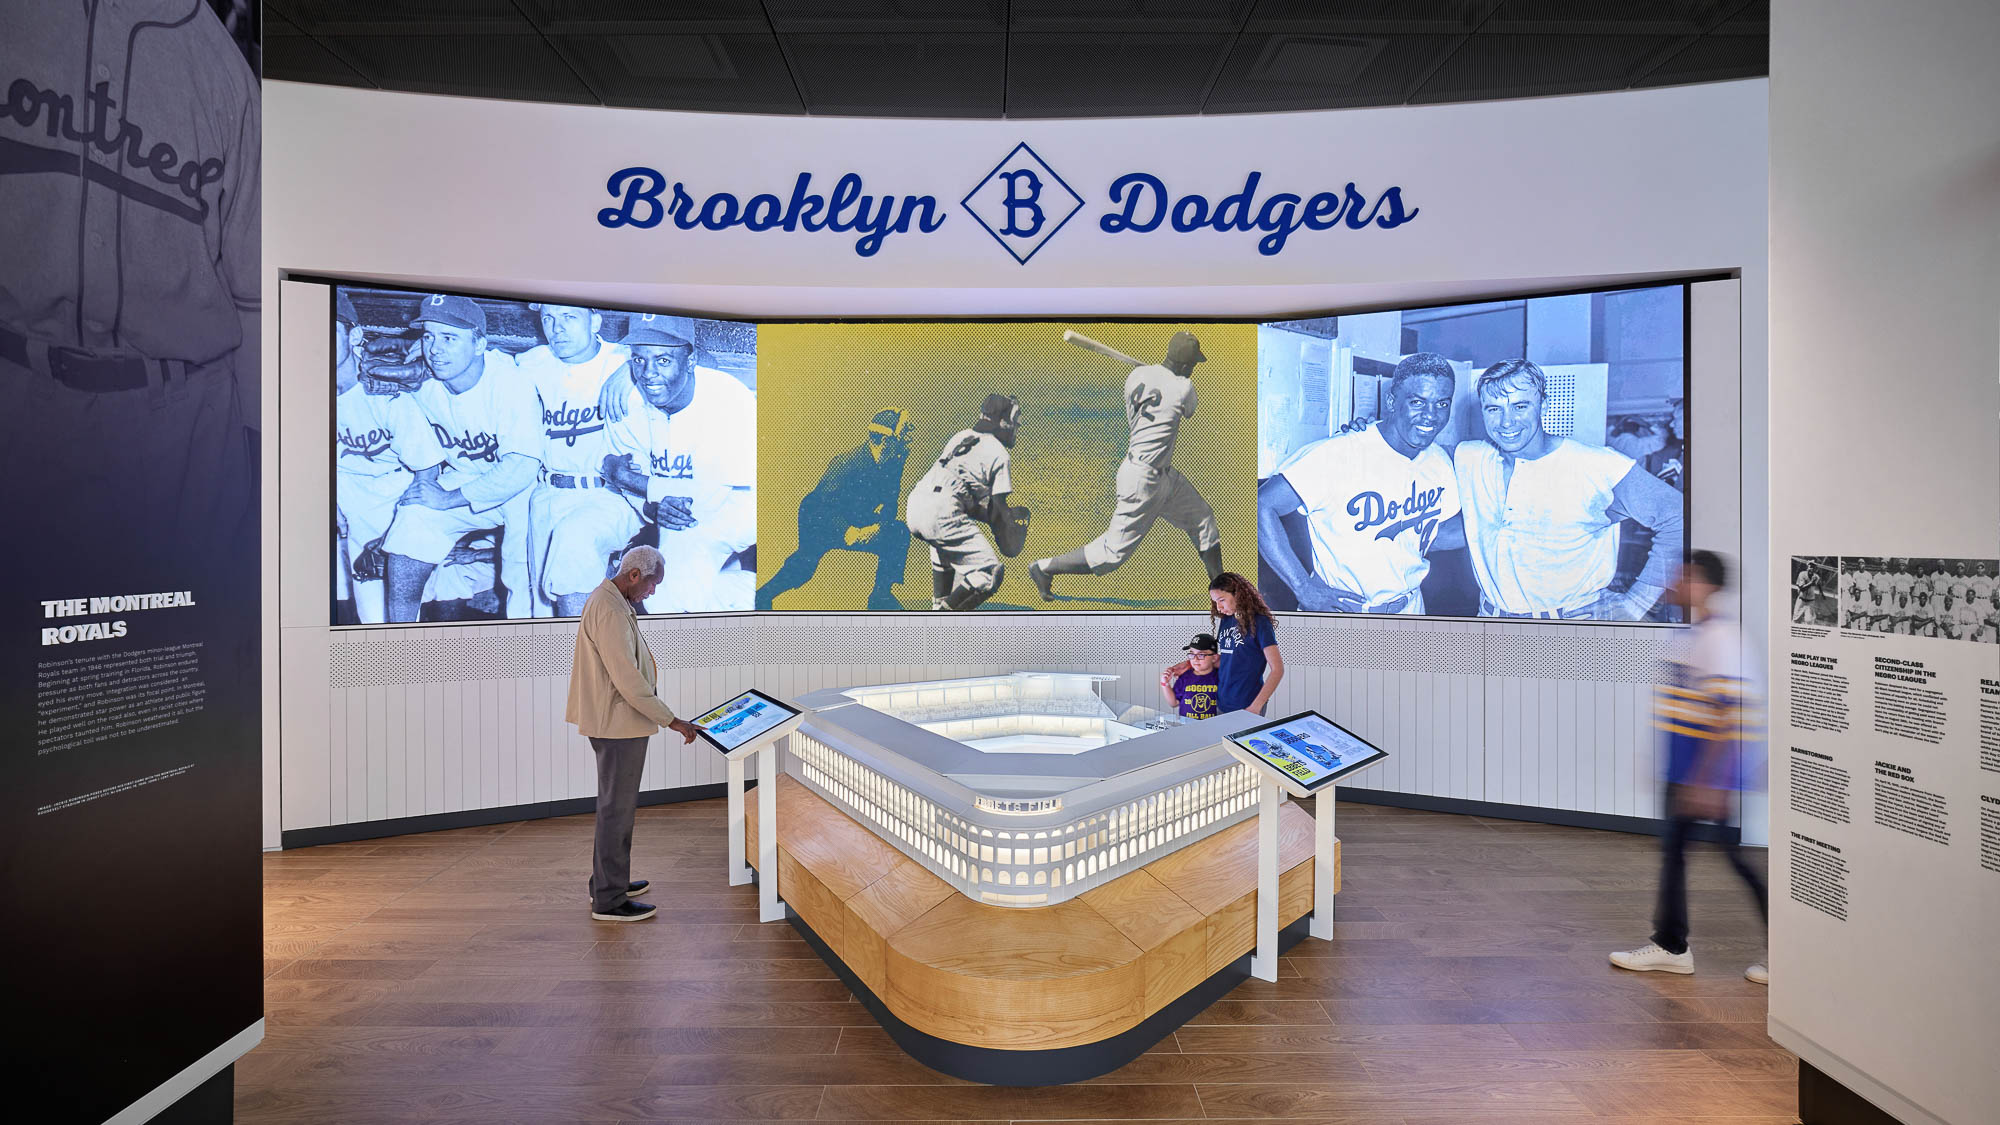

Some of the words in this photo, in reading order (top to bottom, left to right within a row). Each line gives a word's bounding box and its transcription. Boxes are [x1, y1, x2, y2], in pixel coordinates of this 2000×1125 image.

[597, 166, 946, 257] Brooklyn
[999, 169, 1046, 238] B
[1100, 171, 1419, 256] Dodgers
[41, 598, 88, 618] THE
[90, 591, 195, 614] MONTREAL
[42, 620, 127, 646] ROYALS
[1810, 662, 1833, 670] LEAGUES
[1875, 656, 1923, 668] SECOND-CLASS
[1875, 664, 1914, 674] CITIZENSHIP
[1923, 670, 1936, 678] THE
[1875, 671, 1896, 679] NEGRO
[1897, 675, 1927, 684] LEAGUES
[1791, 746, 1833, 761] BARNSTORMING
[1875, 760, 1896, 770] JACKIE
[1897, 766, 1911, 774] AND
[1888, 771, 1900, 779] RED
[1901, 775, 1914, 783] SOX
[1791, 831, 1800, 839] THE
[1816, 840, 1841, 853] MEETING
